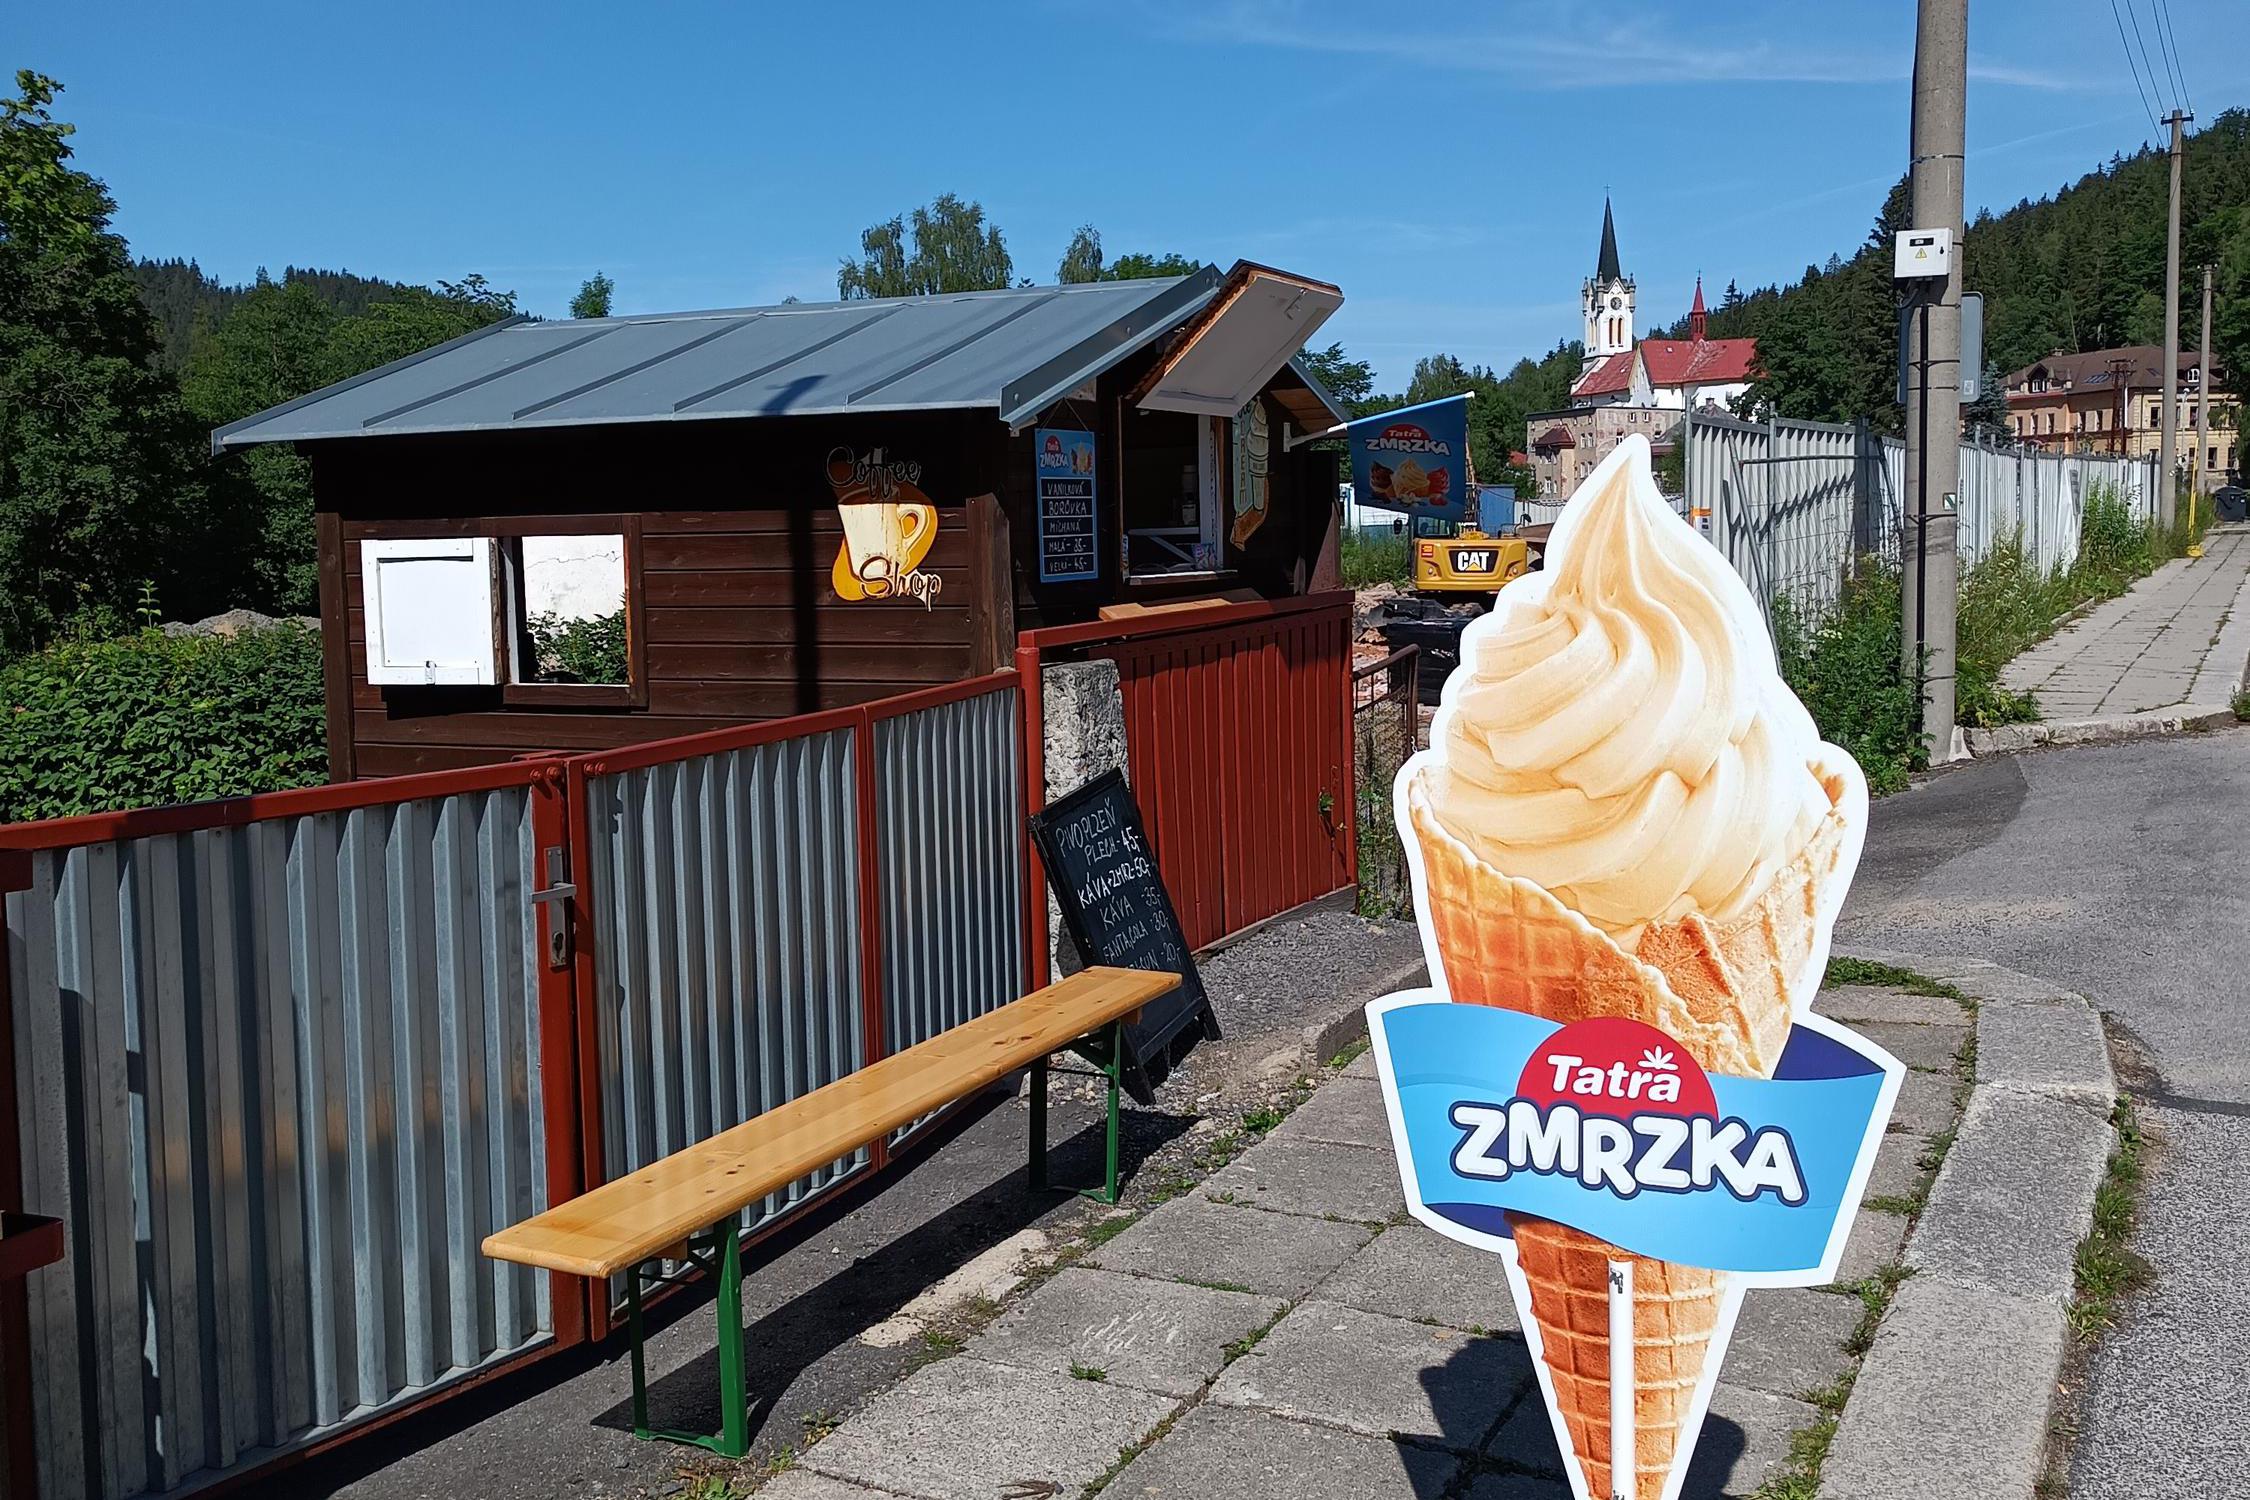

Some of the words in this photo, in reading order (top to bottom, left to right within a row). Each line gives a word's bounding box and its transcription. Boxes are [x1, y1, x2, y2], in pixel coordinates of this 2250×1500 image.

[1040, 452, 1069, 469] ZMRZKA
[1364, 438, 1451, 456] ZMRZKA
[1457, 551, 1489, 571] CAT
[860, 555, 942, 611] Shop
[1099, 895, 1135, 932] KÁVA
[1547, 1052, 1682, 1103] Tatra
[1453, 1100, 1804, 1203] ZMRZKA
